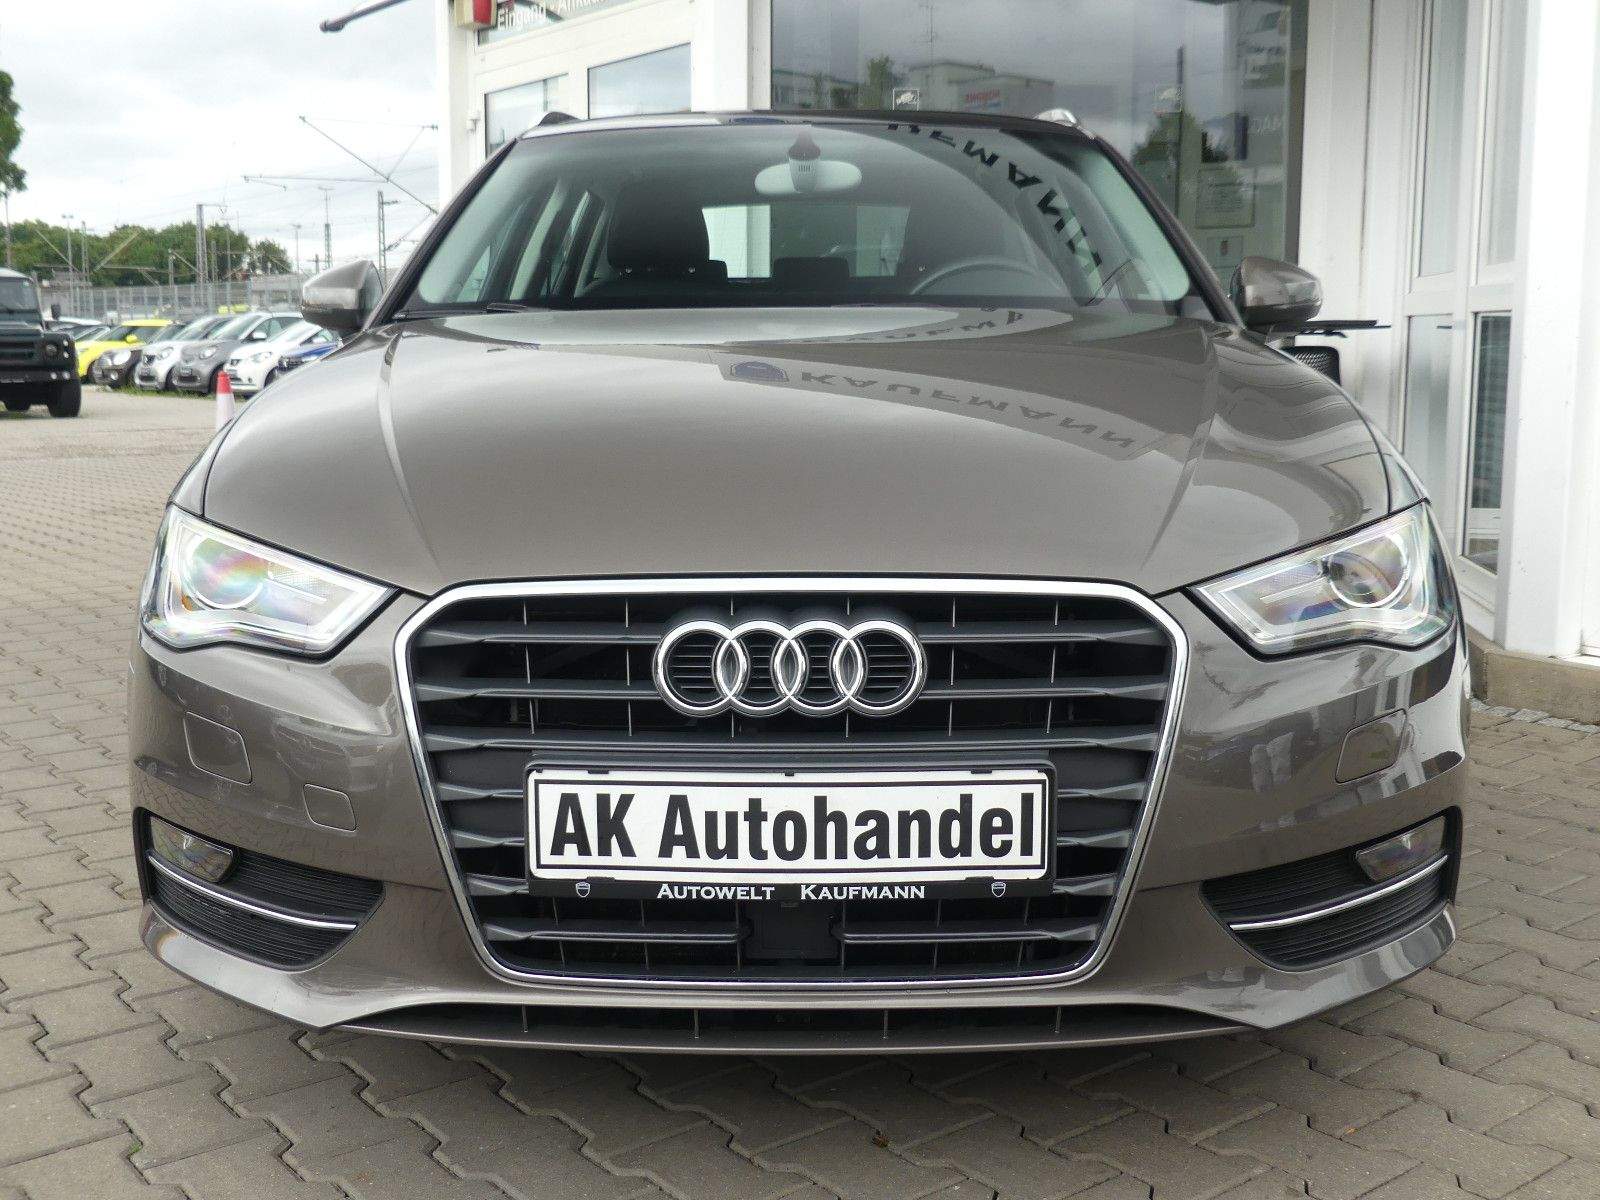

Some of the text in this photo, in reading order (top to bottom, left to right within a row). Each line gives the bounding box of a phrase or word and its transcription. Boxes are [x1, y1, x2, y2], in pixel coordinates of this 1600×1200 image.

[549, 792, 1035, 862] AK Autohandel
[656, 883, 926, 901] AUTOWELT KAUFMANN
